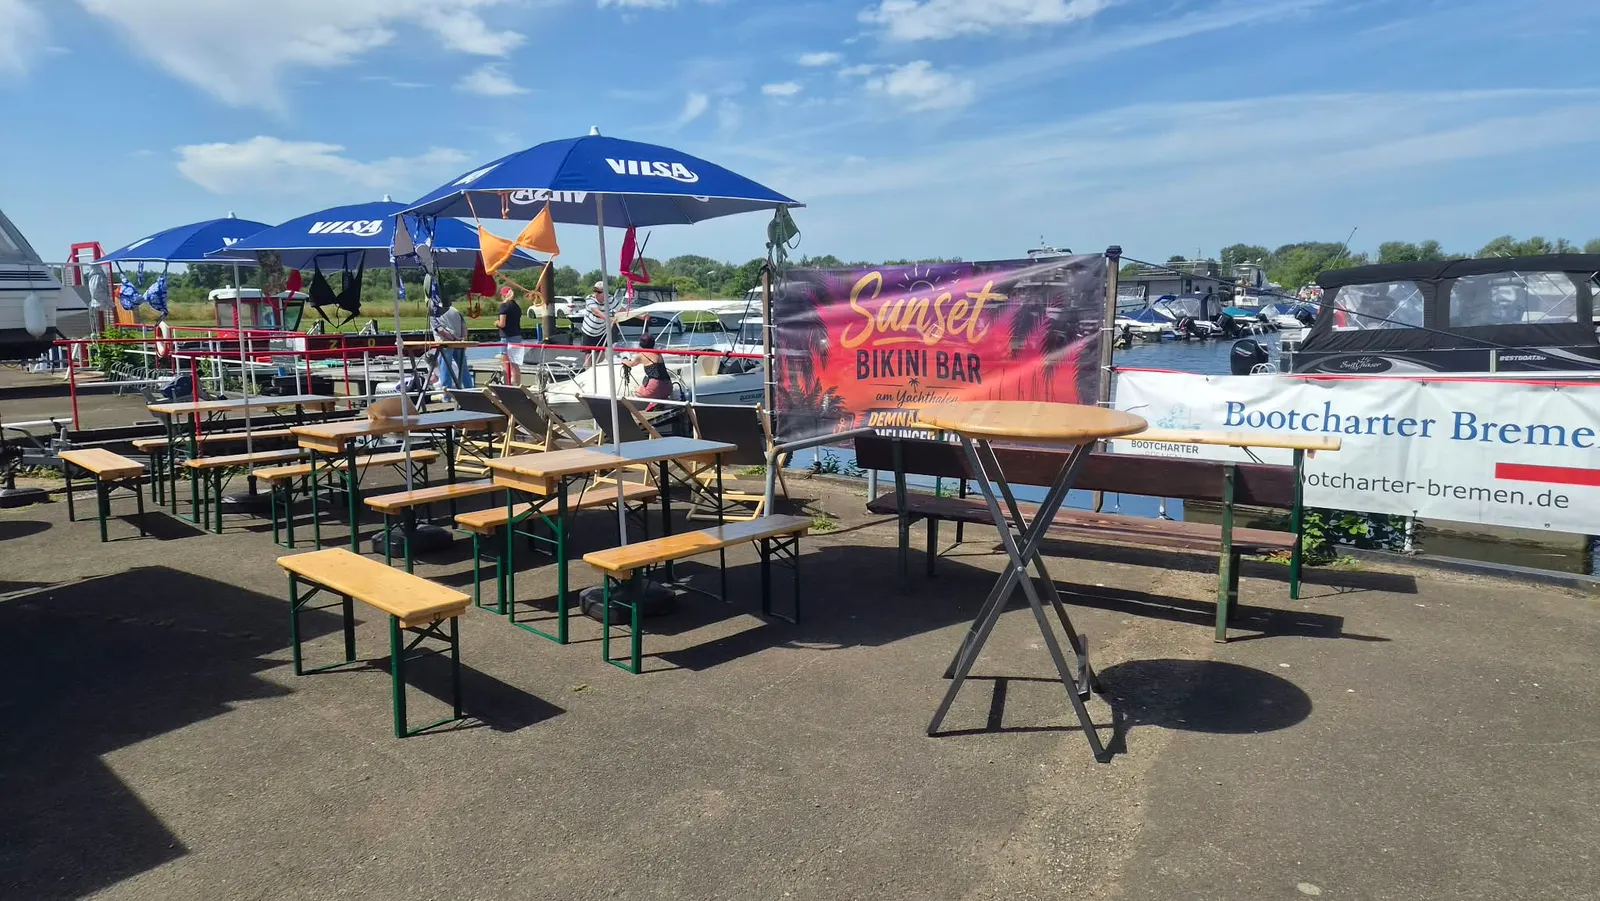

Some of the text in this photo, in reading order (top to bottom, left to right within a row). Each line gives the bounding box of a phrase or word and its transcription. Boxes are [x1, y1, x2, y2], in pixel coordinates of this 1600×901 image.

[605, 157, 699, 184] VILSA
[308, 219, 383, 237] VILSA
[839, 271, 1009, 349] Sunset
[856, 350, 982, 384] BIKINI BAR
[875, 392, 895, 402] am
[868, 411, 920, 427] DEMNÄ
[1223, 400, 1600, 449] Bootcharter Breme
[1131, 440, 1199, 454] BOOTCHARTER
[1303, 471, 1569, 509] otcharter-bremen.de
